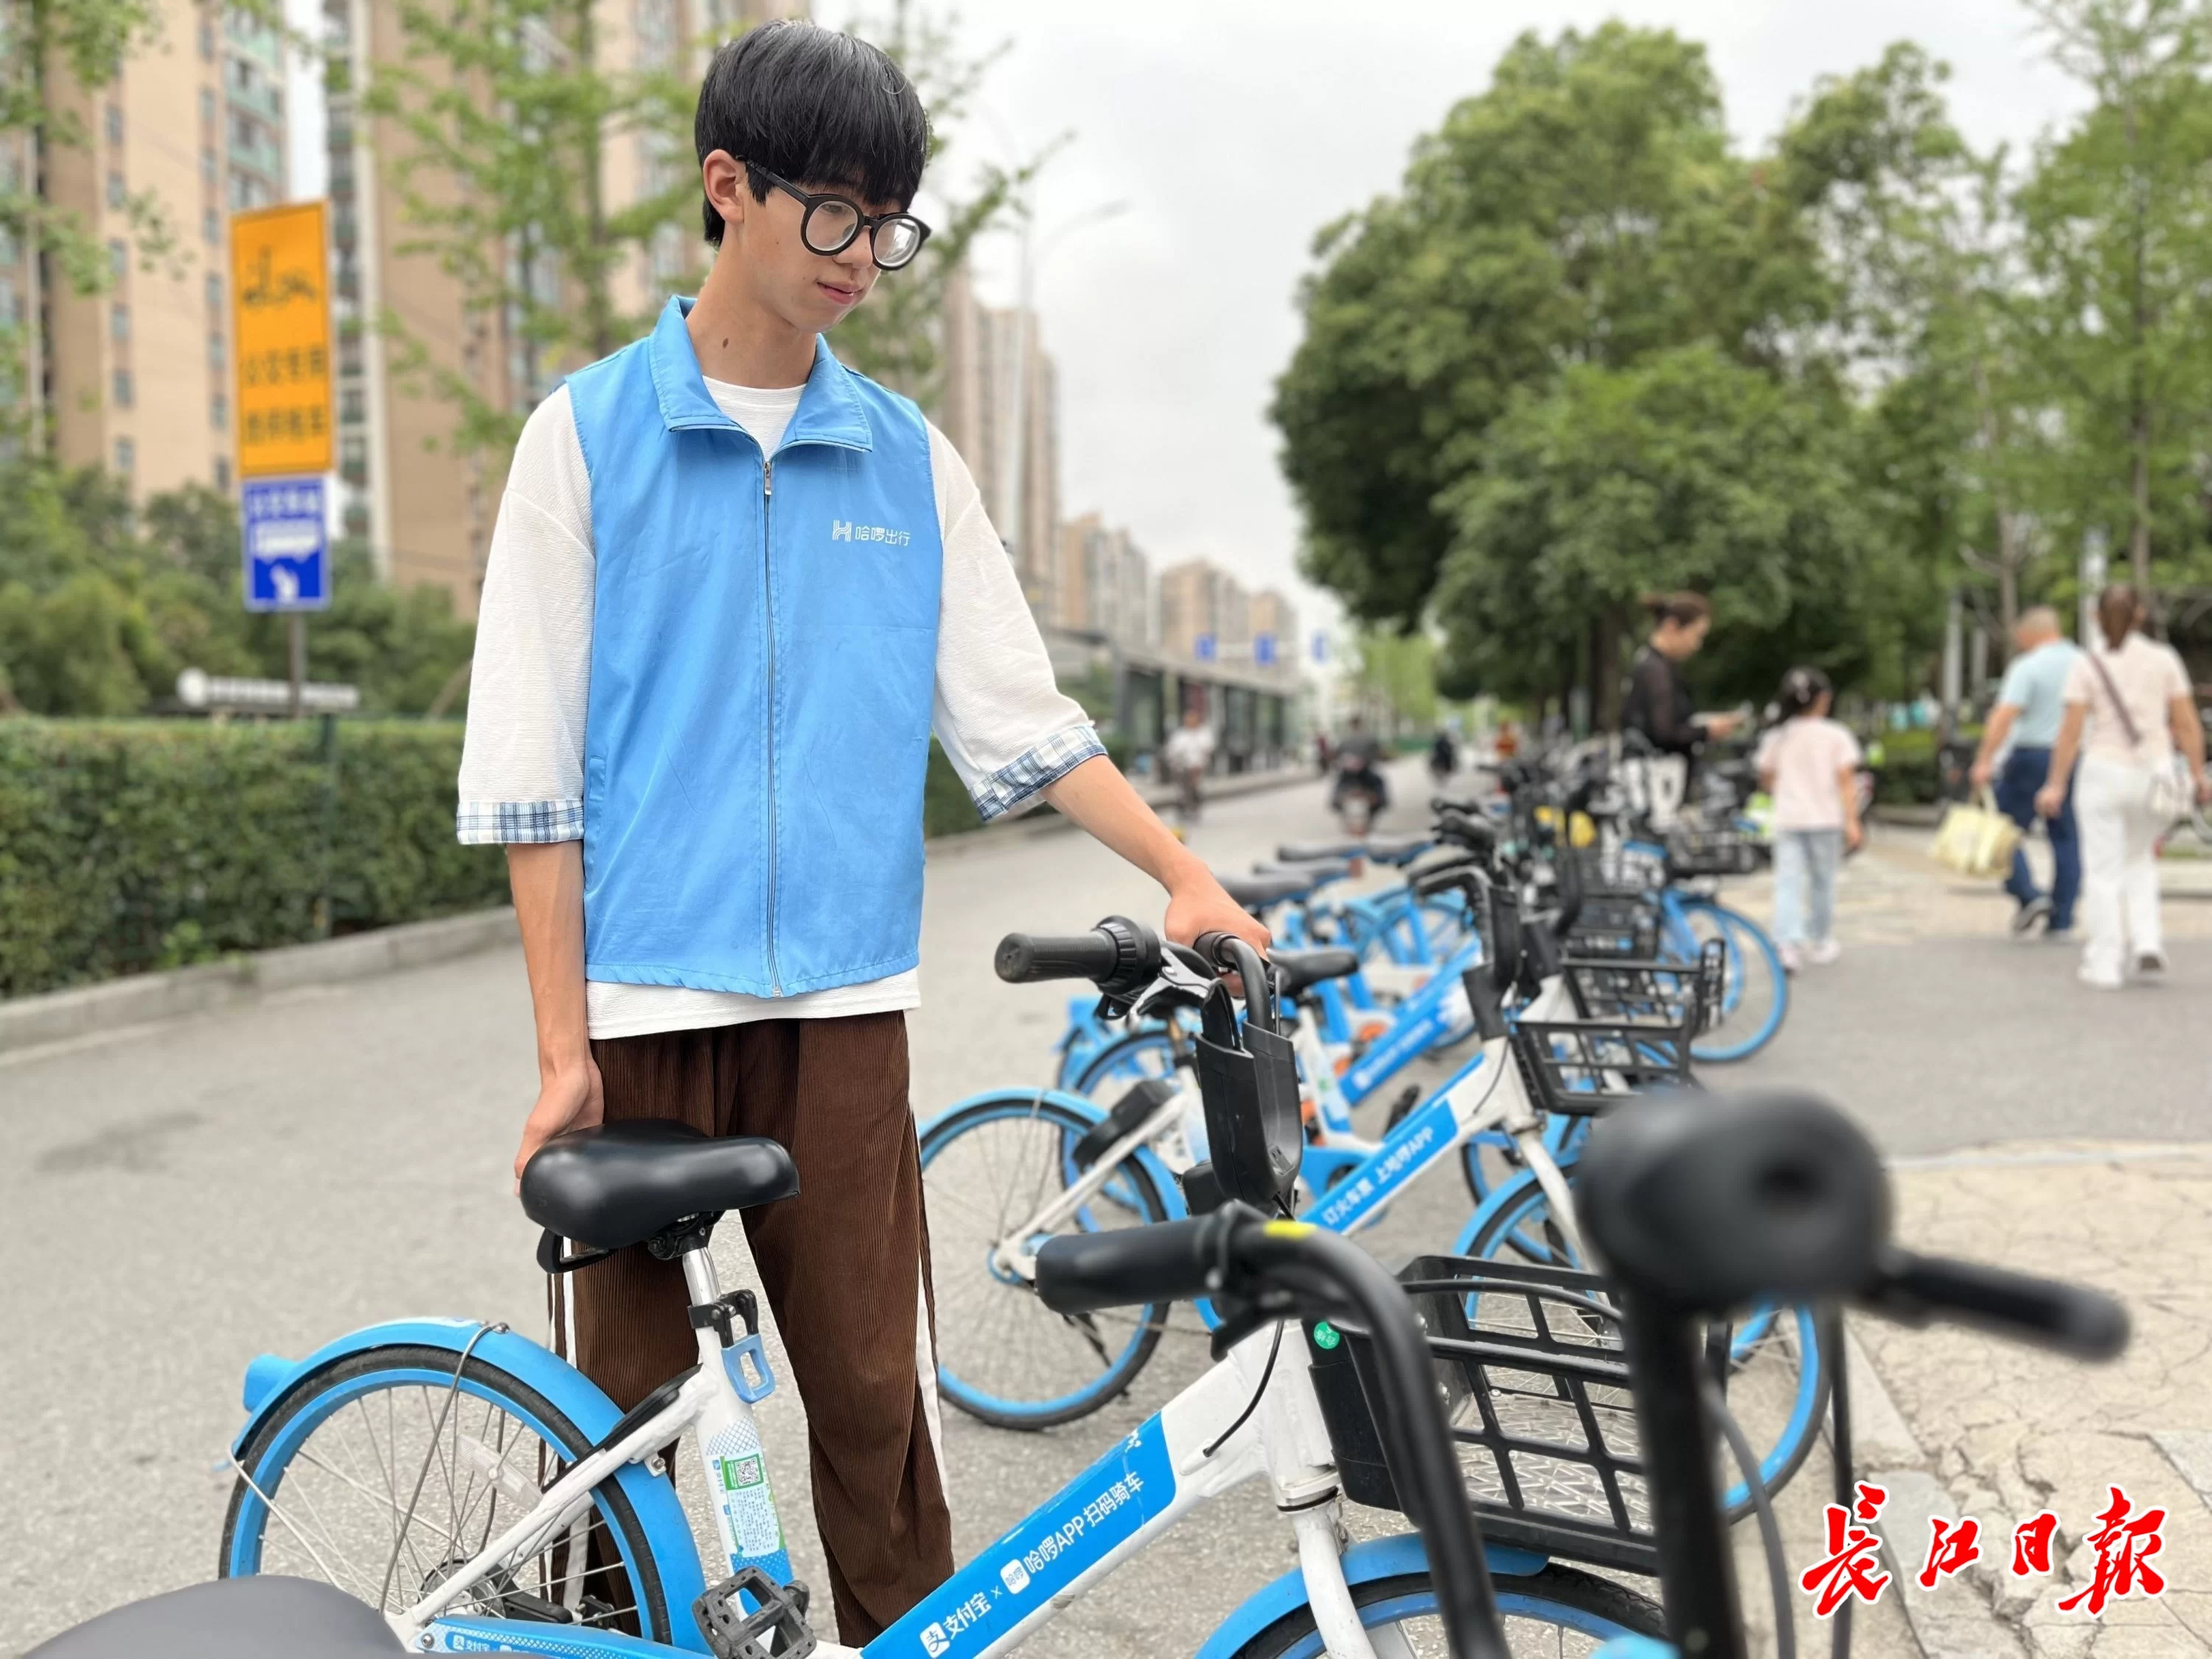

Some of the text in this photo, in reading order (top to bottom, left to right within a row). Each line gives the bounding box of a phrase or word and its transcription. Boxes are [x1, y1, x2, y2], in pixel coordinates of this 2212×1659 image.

[855, 525, 911, 546] 哈啰出行
[943, 1591, 992, 1641] 支付宝
[1023, 1513, 1085, 1574] 哈啰APP
[1082, 1471, 1144, 1528] 扫码骑车
